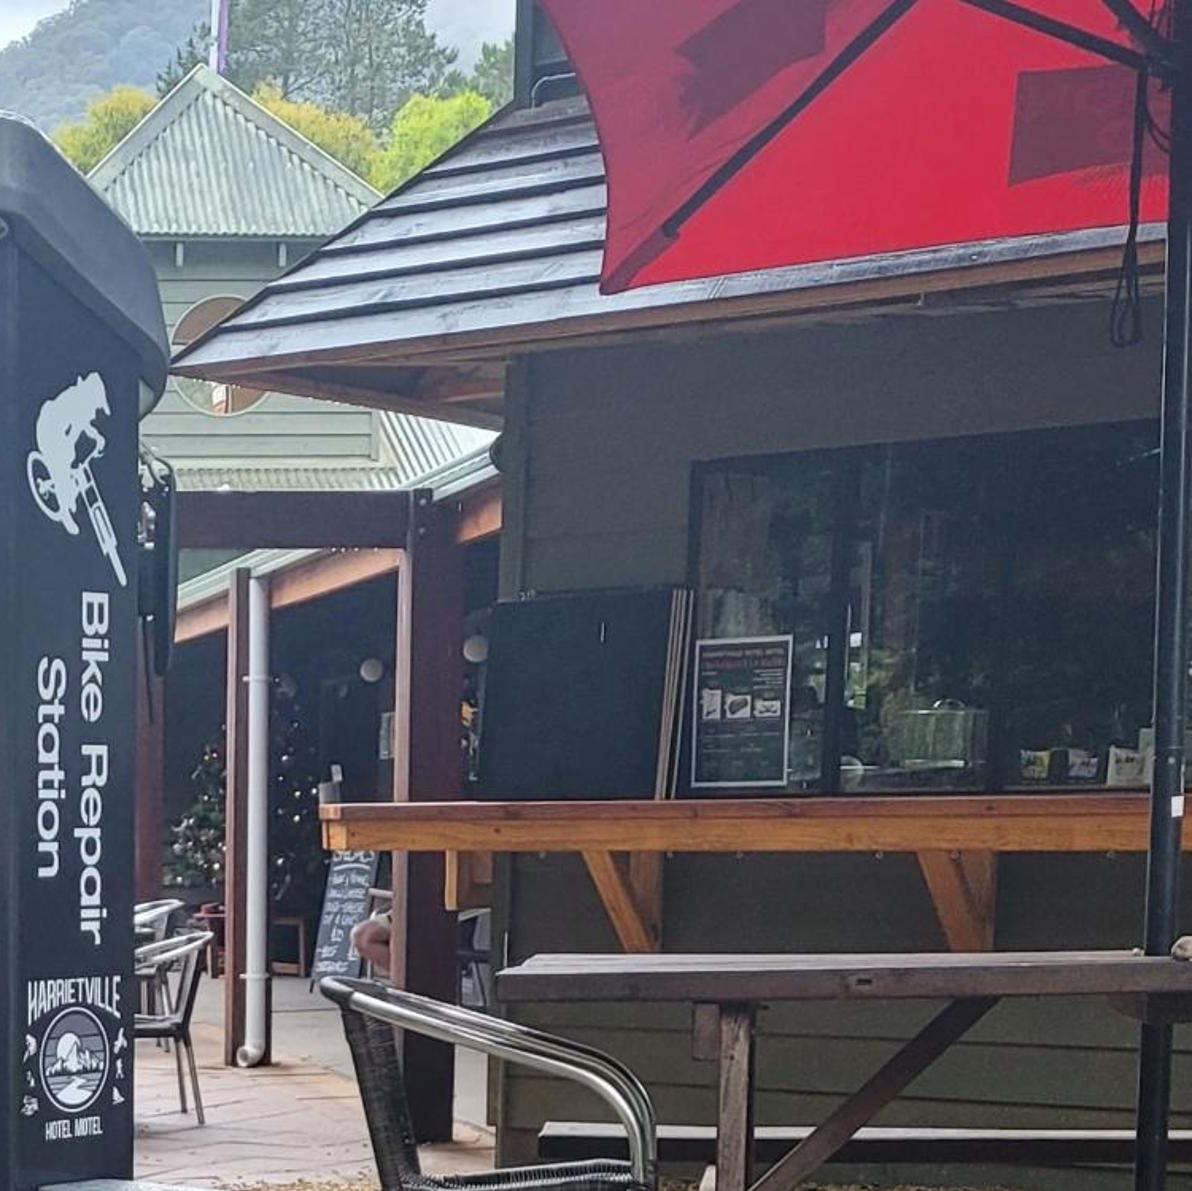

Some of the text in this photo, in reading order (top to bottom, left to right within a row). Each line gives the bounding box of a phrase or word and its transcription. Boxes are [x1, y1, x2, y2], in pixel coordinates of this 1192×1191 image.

[37, 656, 67, 878] Station
[73, 591, 109, 945] Bike Repair
[27, 975, 122, 1026] HARRIETVILLE
[45, 1116, 103, 1141] HOTEL MOTEL
